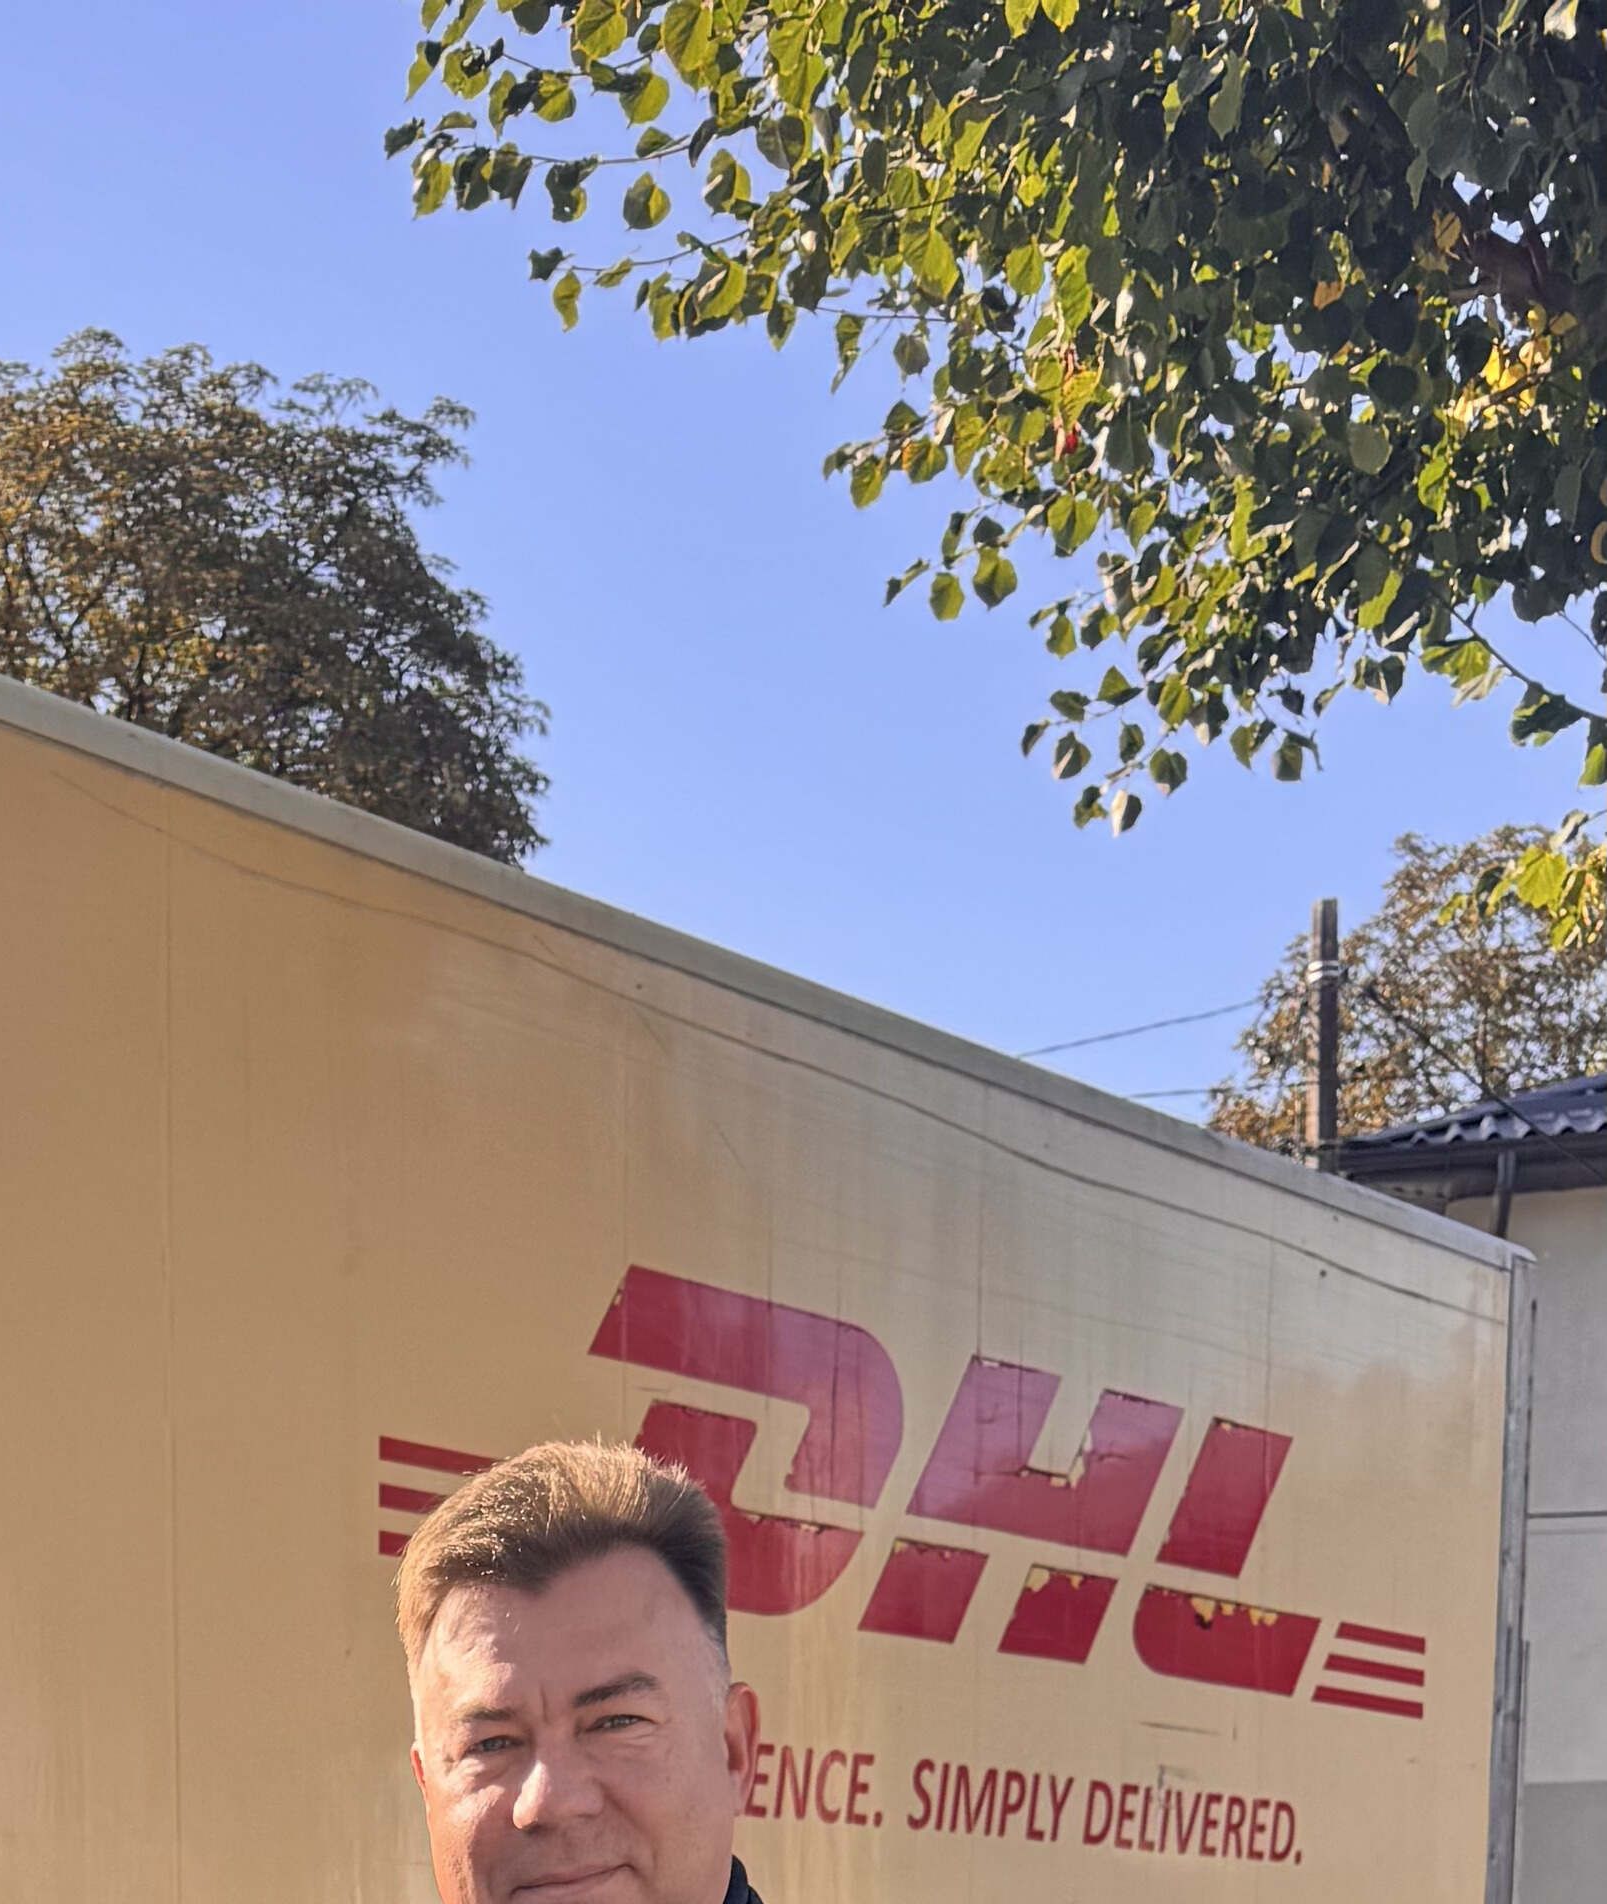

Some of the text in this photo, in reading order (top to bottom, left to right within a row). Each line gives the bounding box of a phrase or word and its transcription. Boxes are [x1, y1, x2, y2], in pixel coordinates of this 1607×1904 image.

[588, 1264, 1321, 1697] DHL
[744, 1743, 1303, 1865] ENCE. SIMPLY DELIVERED.
